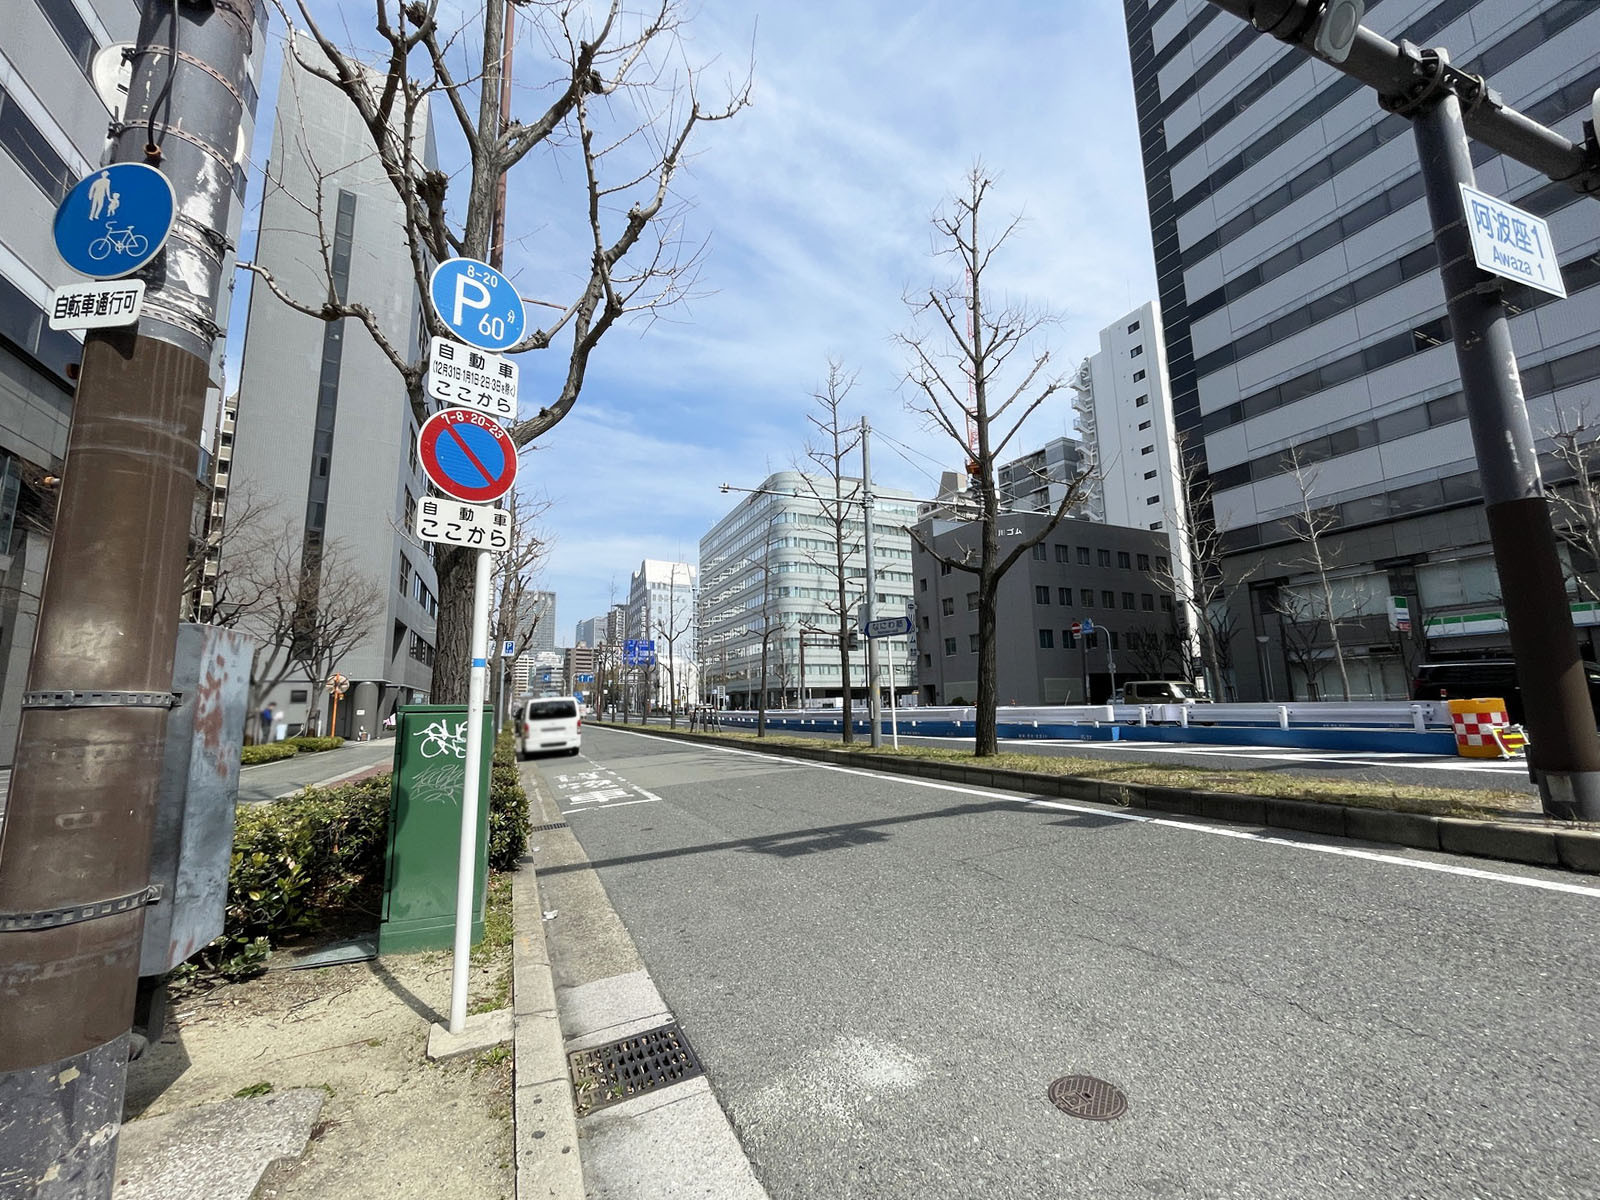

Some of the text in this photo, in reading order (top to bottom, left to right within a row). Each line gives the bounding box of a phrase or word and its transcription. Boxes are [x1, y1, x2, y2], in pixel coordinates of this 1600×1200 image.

[467, 265, 498, 288] 8-20
[1493, 246, 1545, 281] Awaza 1
[54, 290, 138, 320] 自転車通行可
[453, 272, 491, 326] P
[440, 343, 514, 379] 自動車
[436, 380, 511, 413] ここから
[423, 502, 507, 527] 自動車
[421, 519, 507, 547] ここから
